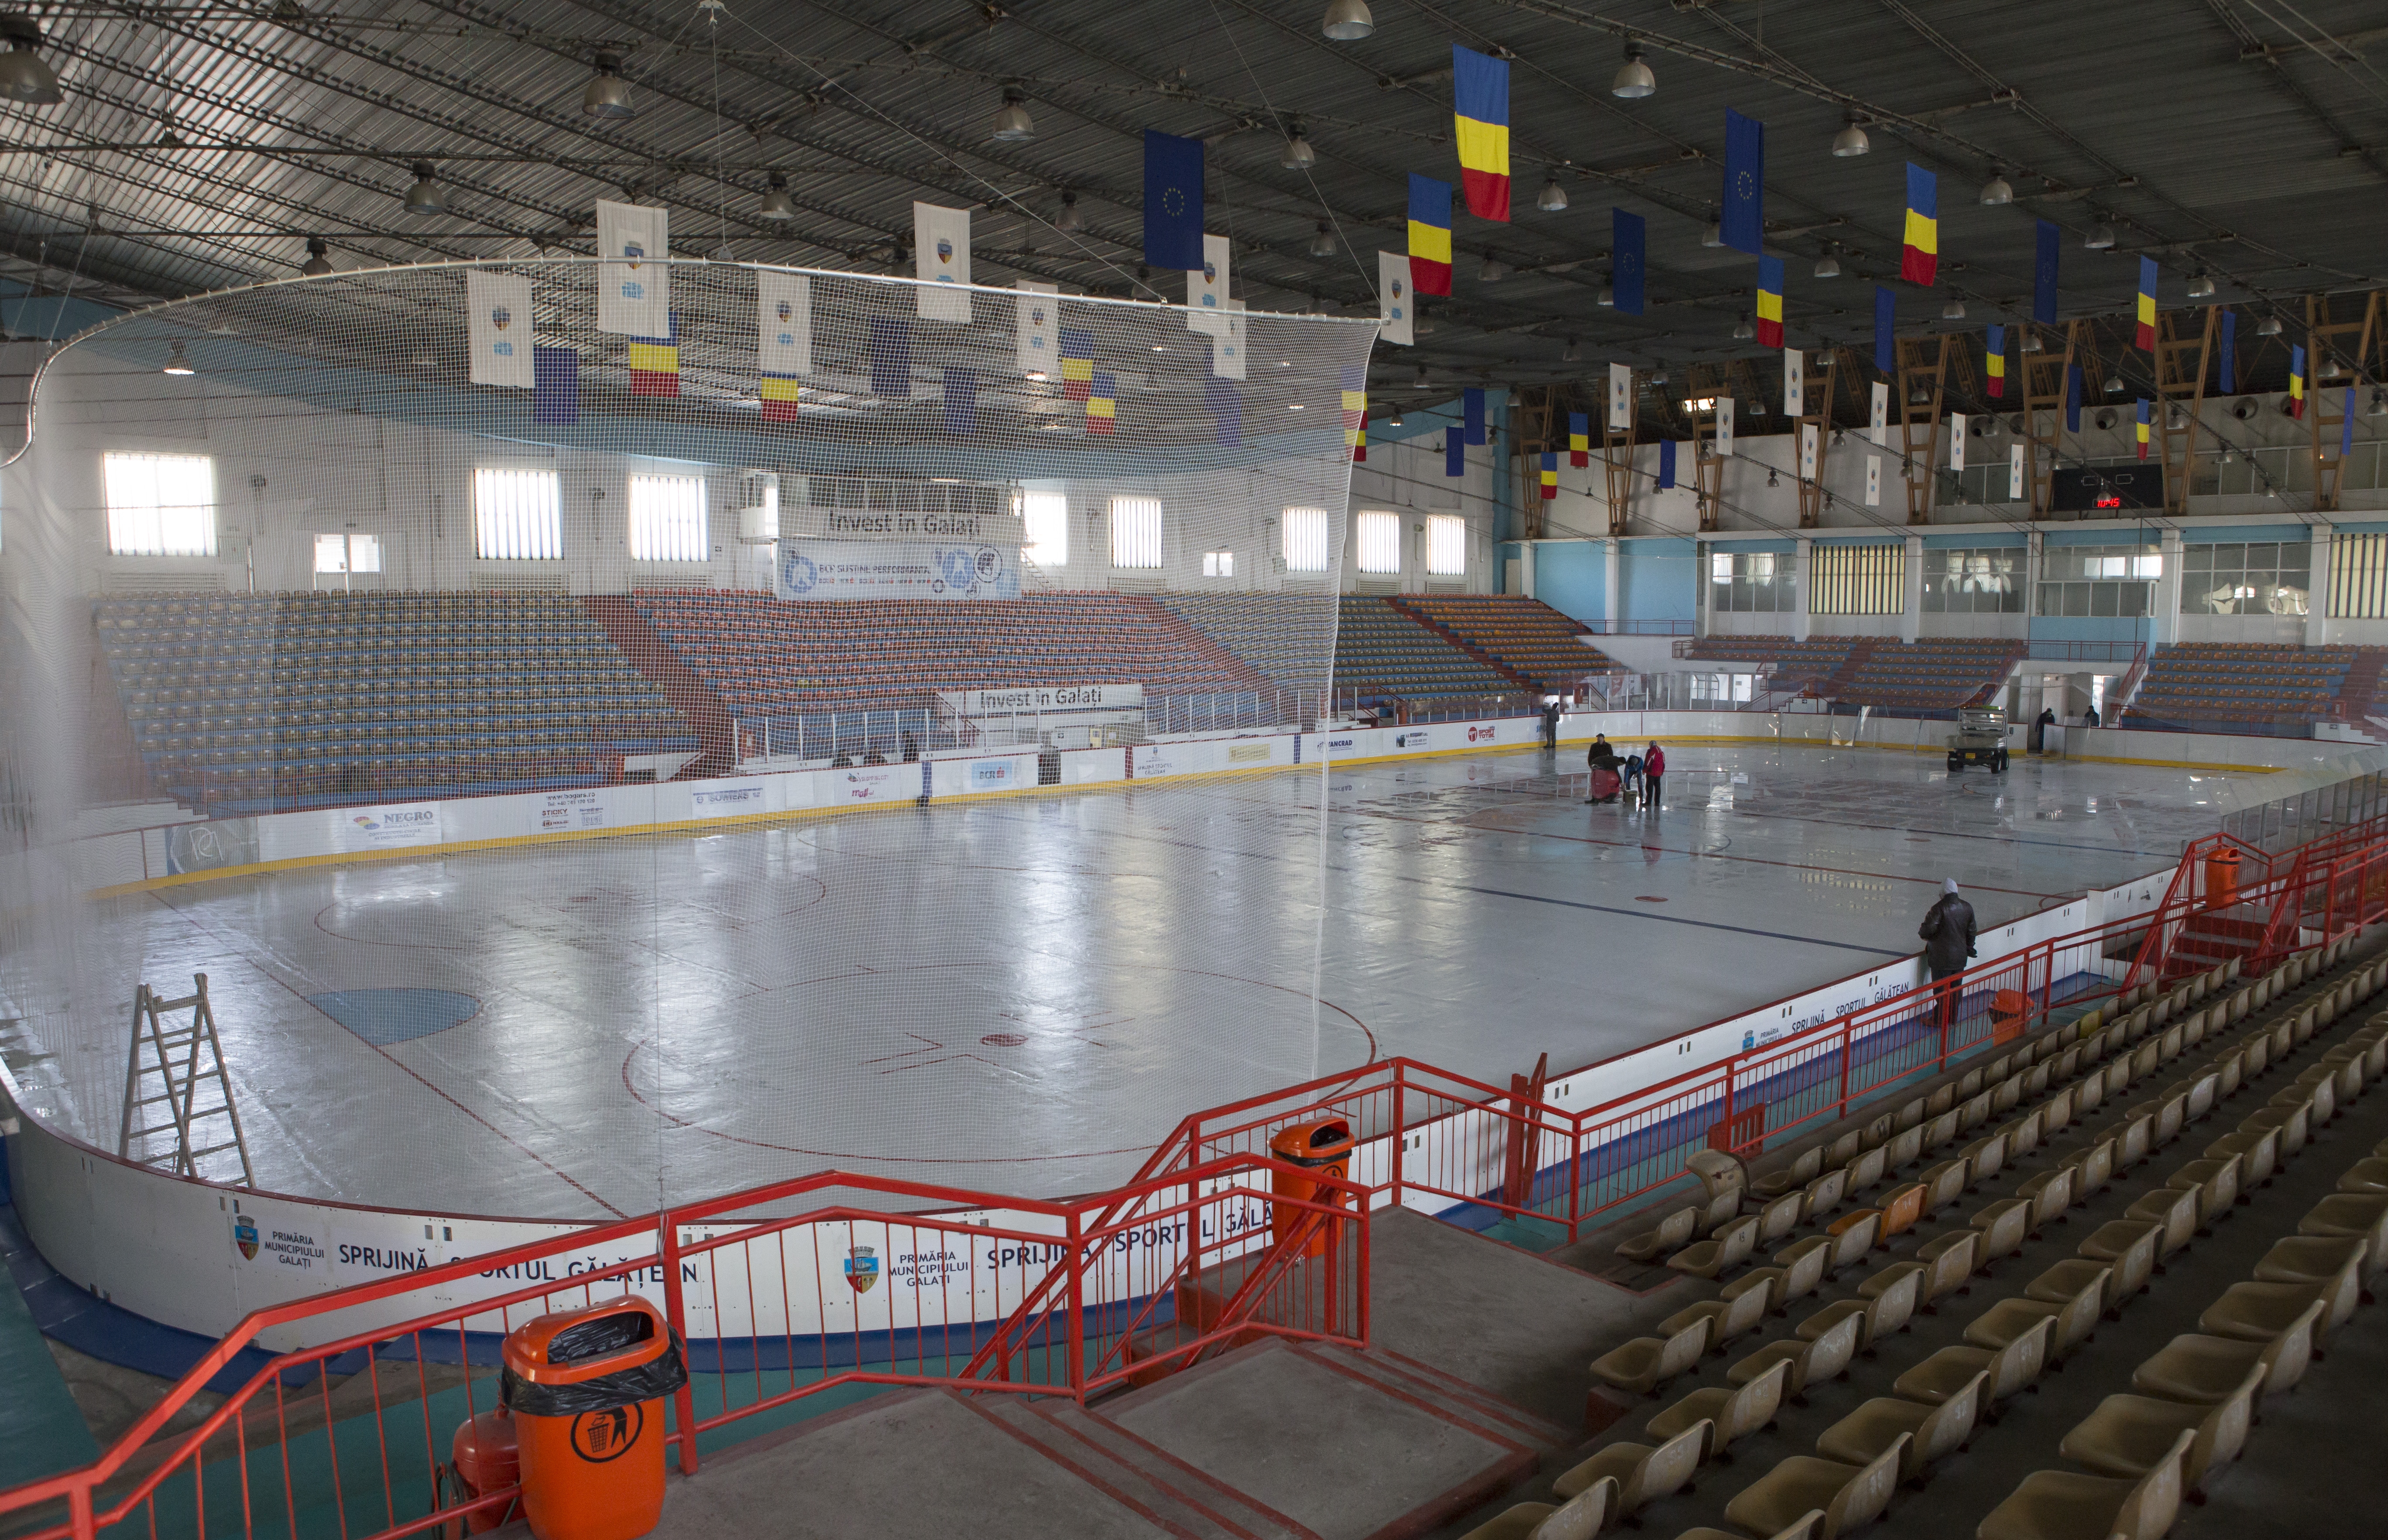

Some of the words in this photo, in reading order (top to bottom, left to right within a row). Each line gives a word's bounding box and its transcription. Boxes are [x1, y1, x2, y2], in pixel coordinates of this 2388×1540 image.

[830, 511, 892, 532] Invest
[899, 513, 916, 532] in
[981, 692, 1030, 708] Invest
[1036, 689, 1050, 705] in
[979, 771, 995, 779] BCR
[384, 811, 433, 823] NEGRO
[1792, 1008, 1825, 1035] SPRIJINĂ
[1836, 997, 1867, 1018] SPORTUL
[1760, 1027, 1778, 1039] PRIMĂRIA
[273, 1231, 314, 1245] PRIMĂRIA
[1115, 1220, 1214, 1252] SPORTL
[265, 1241, 324, 1258] MUNICIPIULUI
[900, 1250, 956, 1263] PRMĂRIA
[279, 1255, 311, 1269] GALAȚI
[339, 1244, 428, 1271] SPRIJINĂ
[569, 1256, 697, 1288] GĂLĂȚEN
[889, 1262, 968, 1276] MUNCIPIULUI
